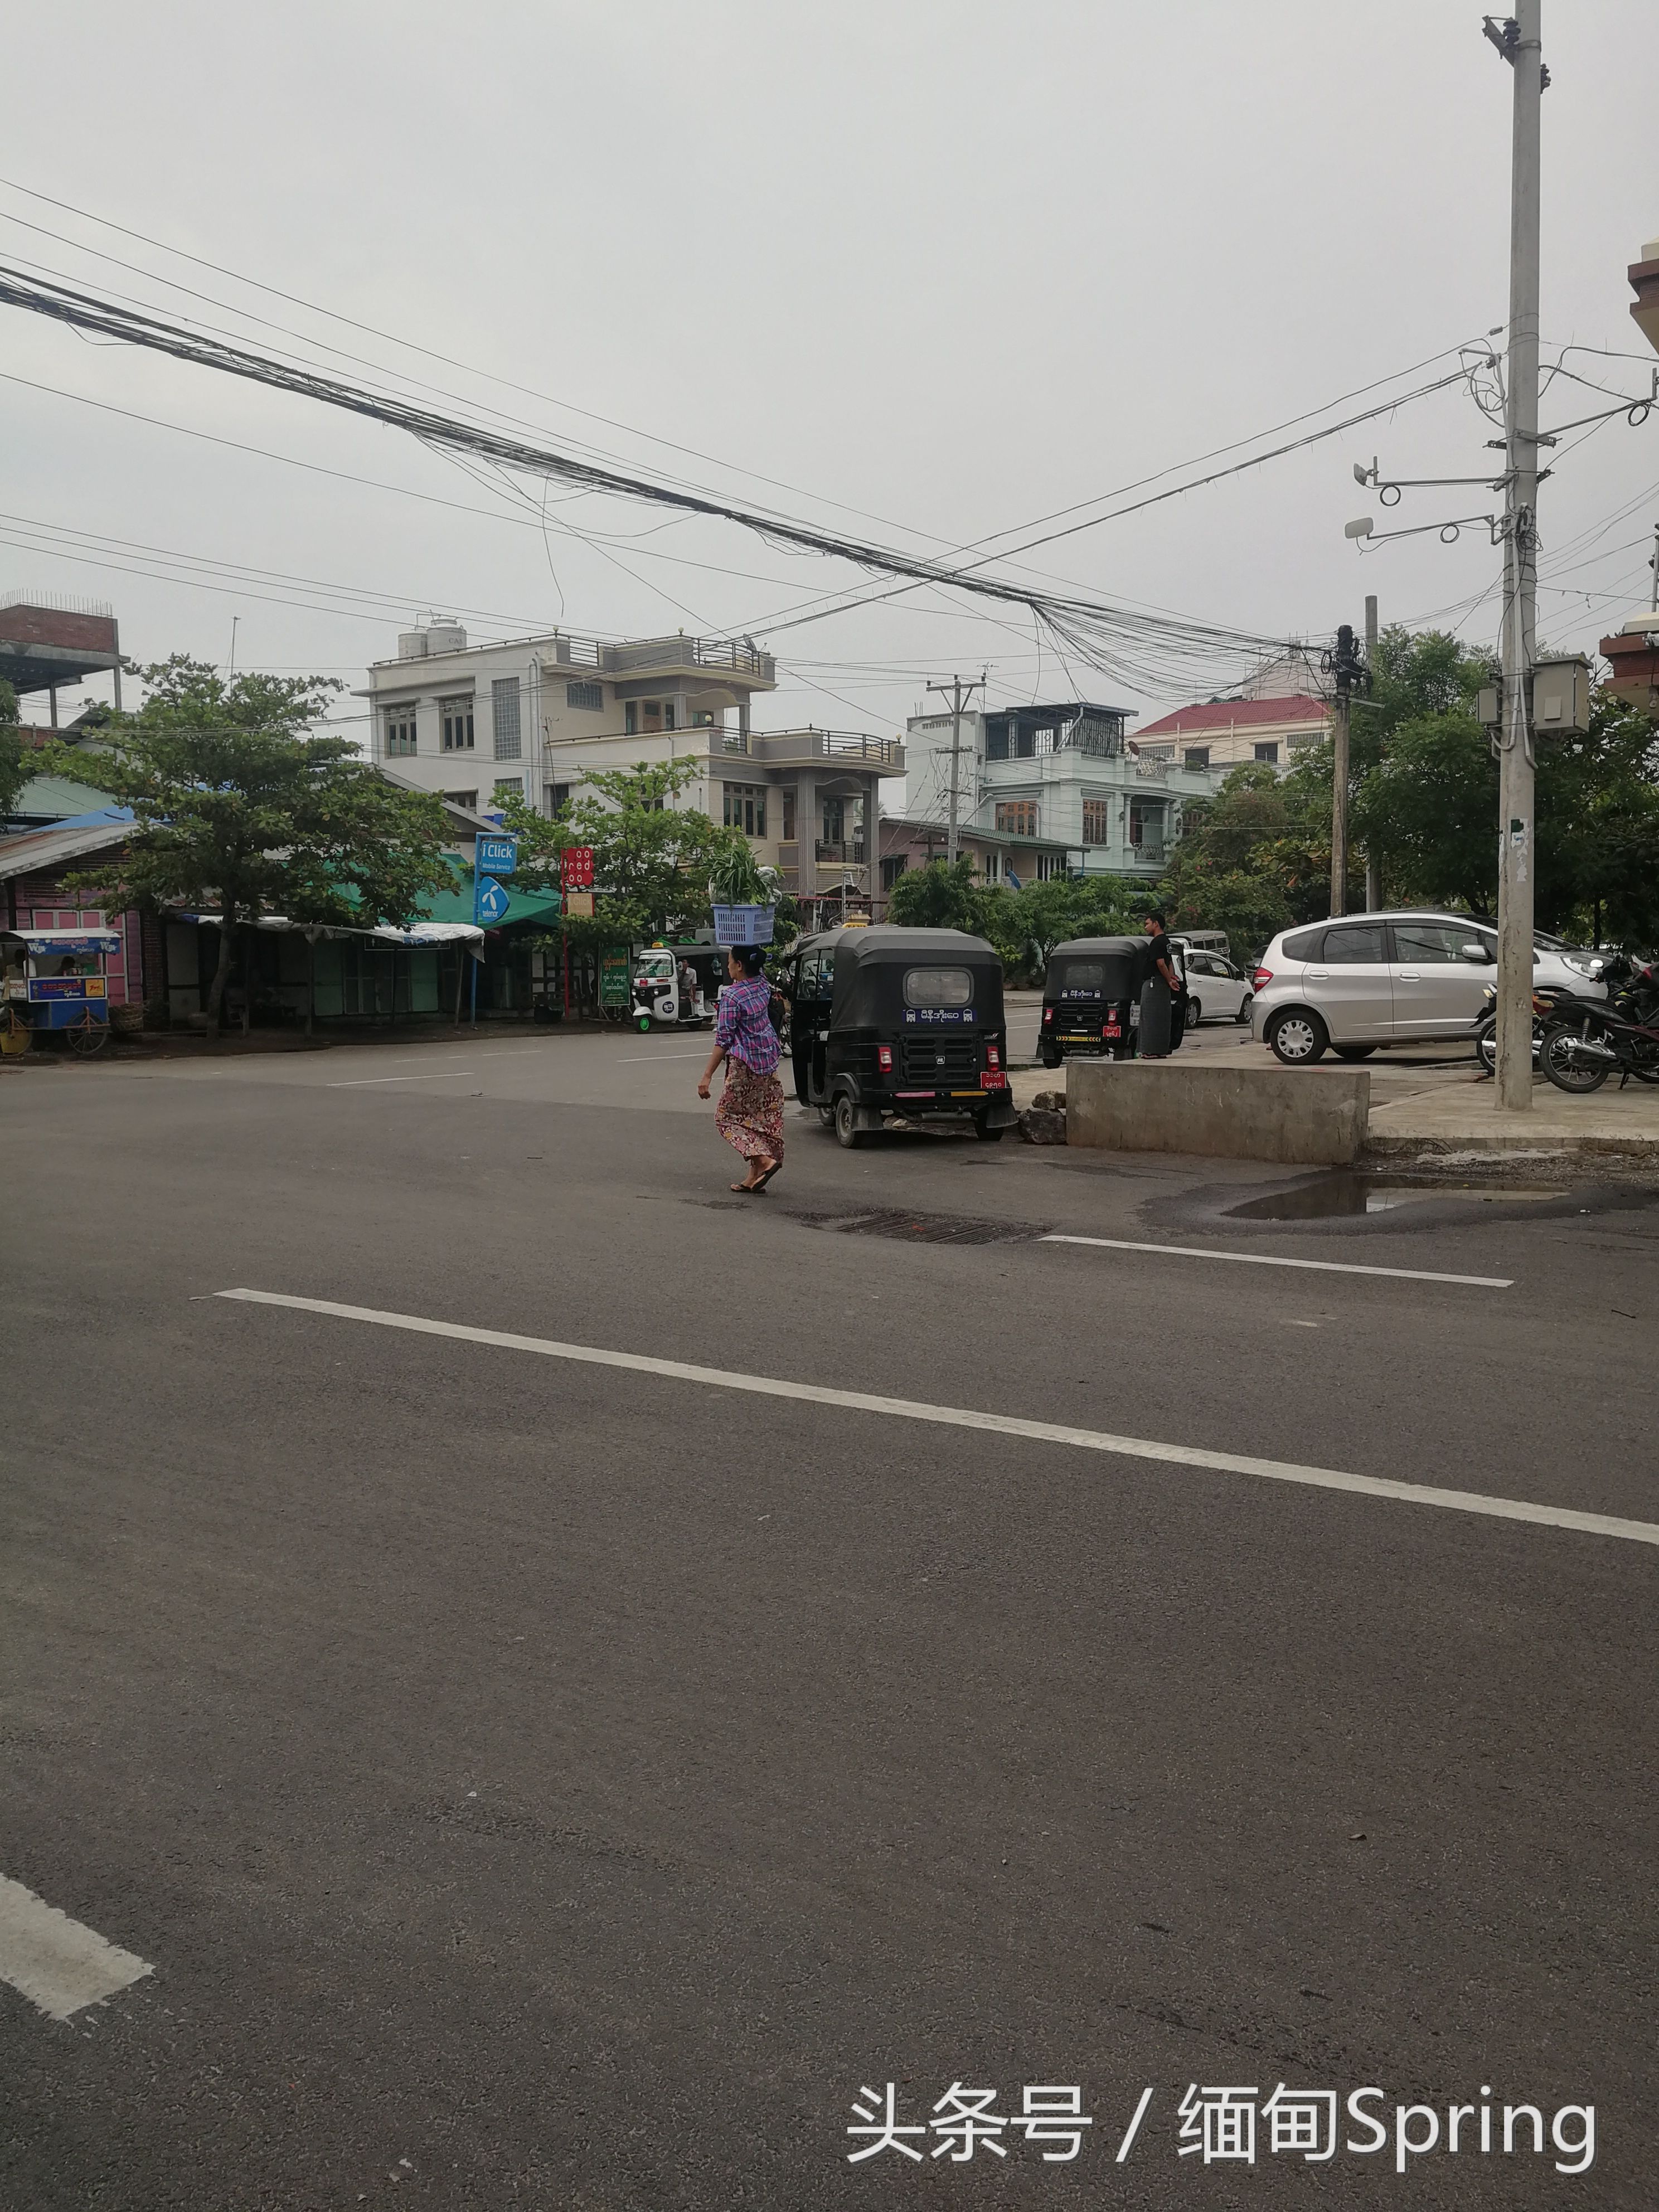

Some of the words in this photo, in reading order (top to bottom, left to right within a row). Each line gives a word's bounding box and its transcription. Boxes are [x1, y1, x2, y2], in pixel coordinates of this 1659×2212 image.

[482, 845, 486, 857] i
[488, 845, 512, 858] Click
[569, 860, 590, 871] red
